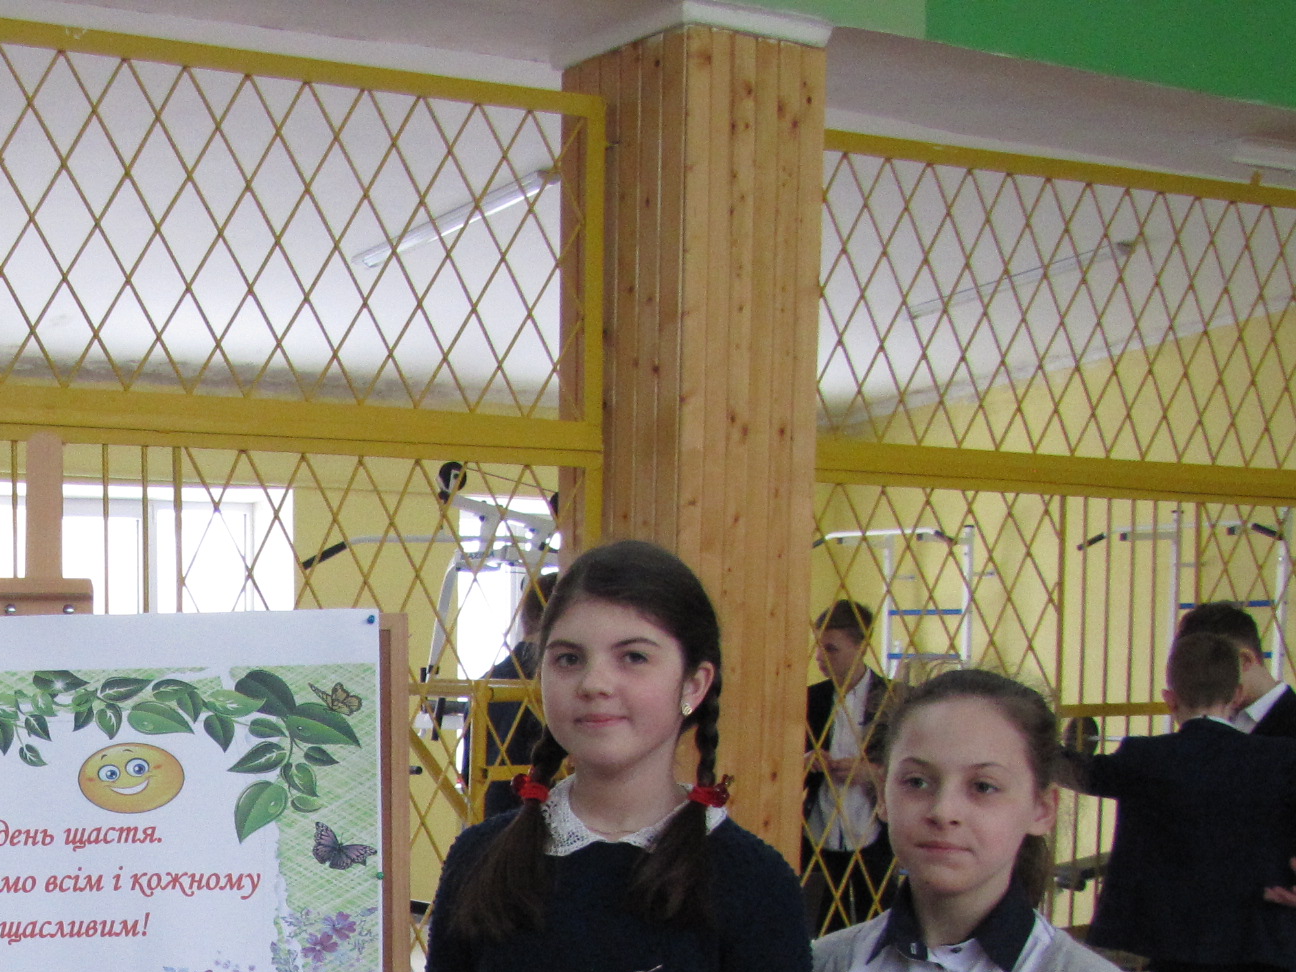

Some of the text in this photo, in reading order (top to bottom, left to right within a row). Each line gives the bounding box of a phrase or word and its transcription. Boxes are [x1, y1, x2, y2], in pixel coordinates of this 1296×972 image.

[63, 824, 162, 851] щастя.
[44, 867, 104, 893] всім
[112, 865, 123, 891] і
[130, 868, 262, 900] кожному
